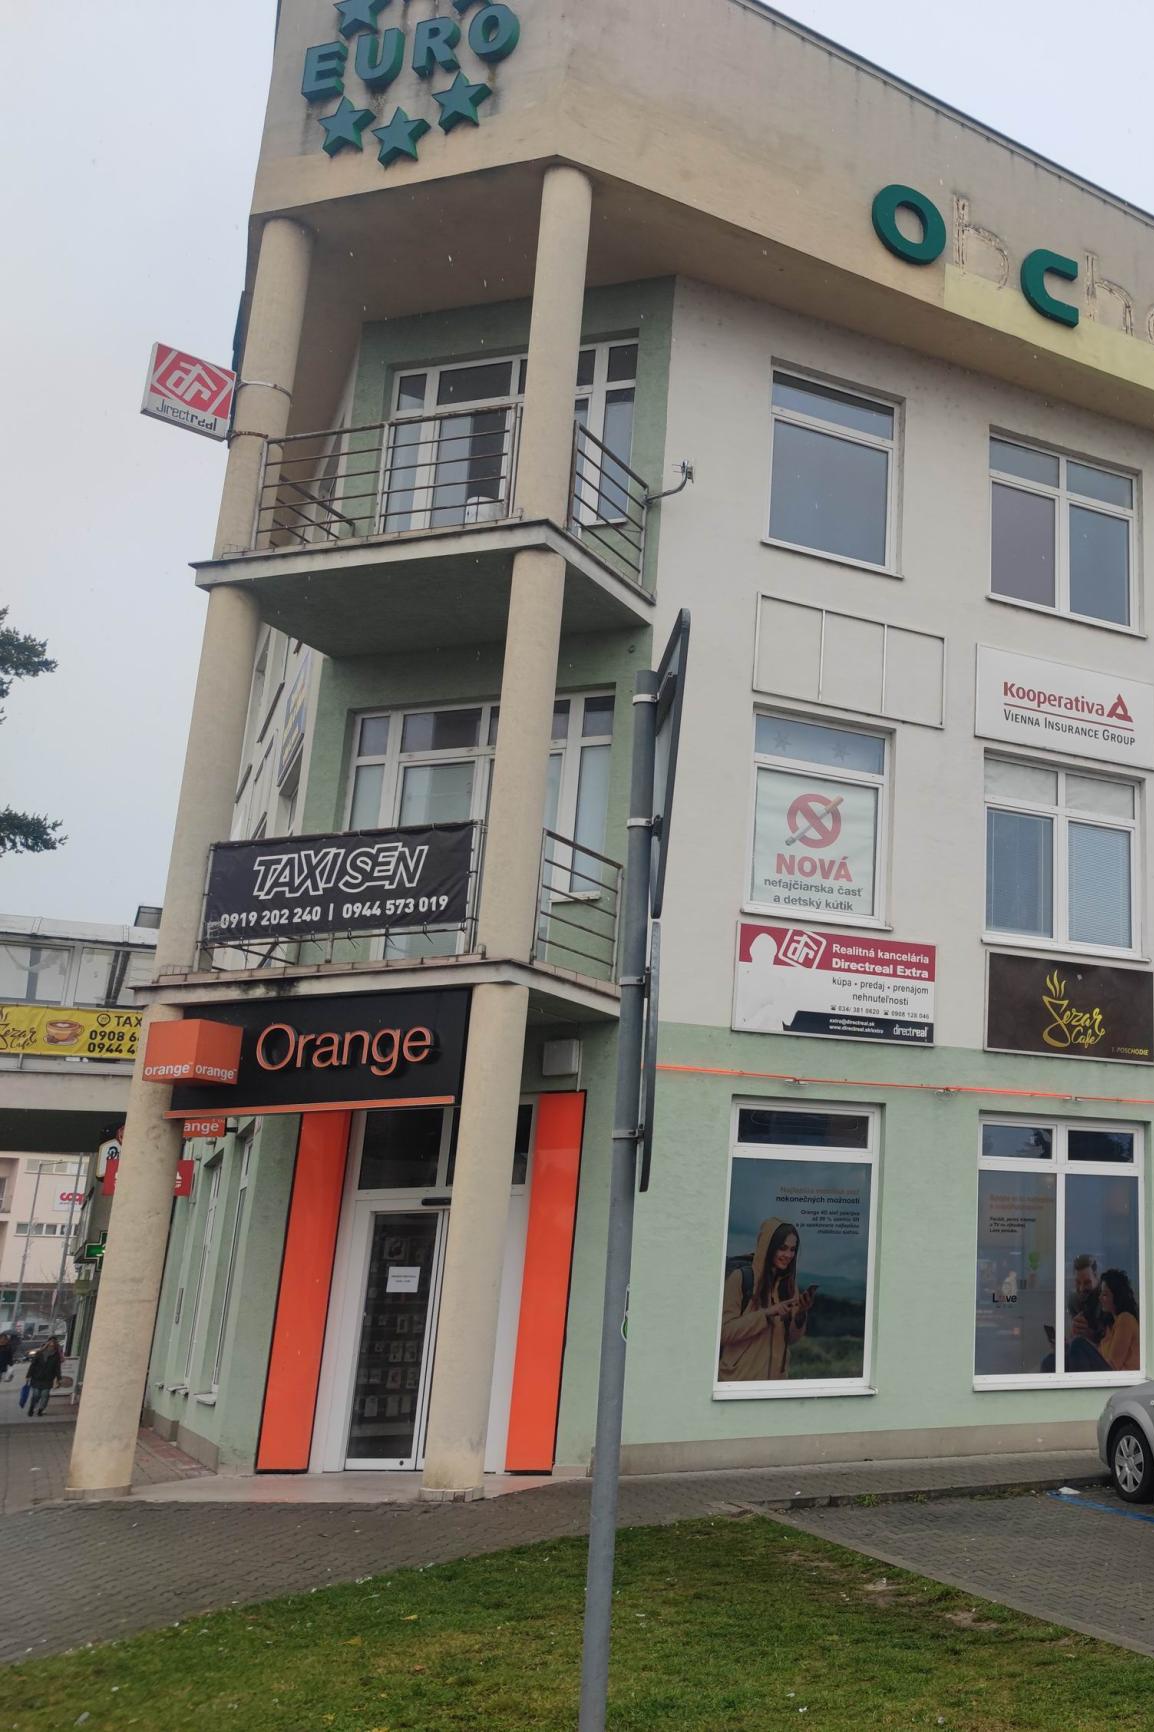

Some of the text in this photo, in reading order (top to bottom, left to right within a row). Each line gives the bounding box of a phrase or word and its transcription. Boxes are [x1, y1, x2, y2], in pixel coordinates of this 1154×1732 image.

[301, 4, 520, 102] EURO
[1003, 681, 1105, 717] Kooperativa
[1004, 709, 1135, 746] VIENNA INSURANCE GROUP
[253, 842, 429, 900] TAXI SEN
[776, 853, 853, 882] NOVÁ
[764, 877, 834, 895] nefajčiarska
[773, 895, 780, 903] a
[221, 895, 448, 929] 0919 202 240 0944 573 019
[832, 943, 929, 963] Realitná kancelária
[832, 958, 929, 979] Directreal Extra
[860, 980, 885, 992] predaj
[89, 1030, 125, 1042] 0908
[256, 1023, 432, 1076] Orange
[144, 1063, 191, 1077] orange
[195, 1064, 234, 1080] orange
[184, 1121, 219, 1133] ange
